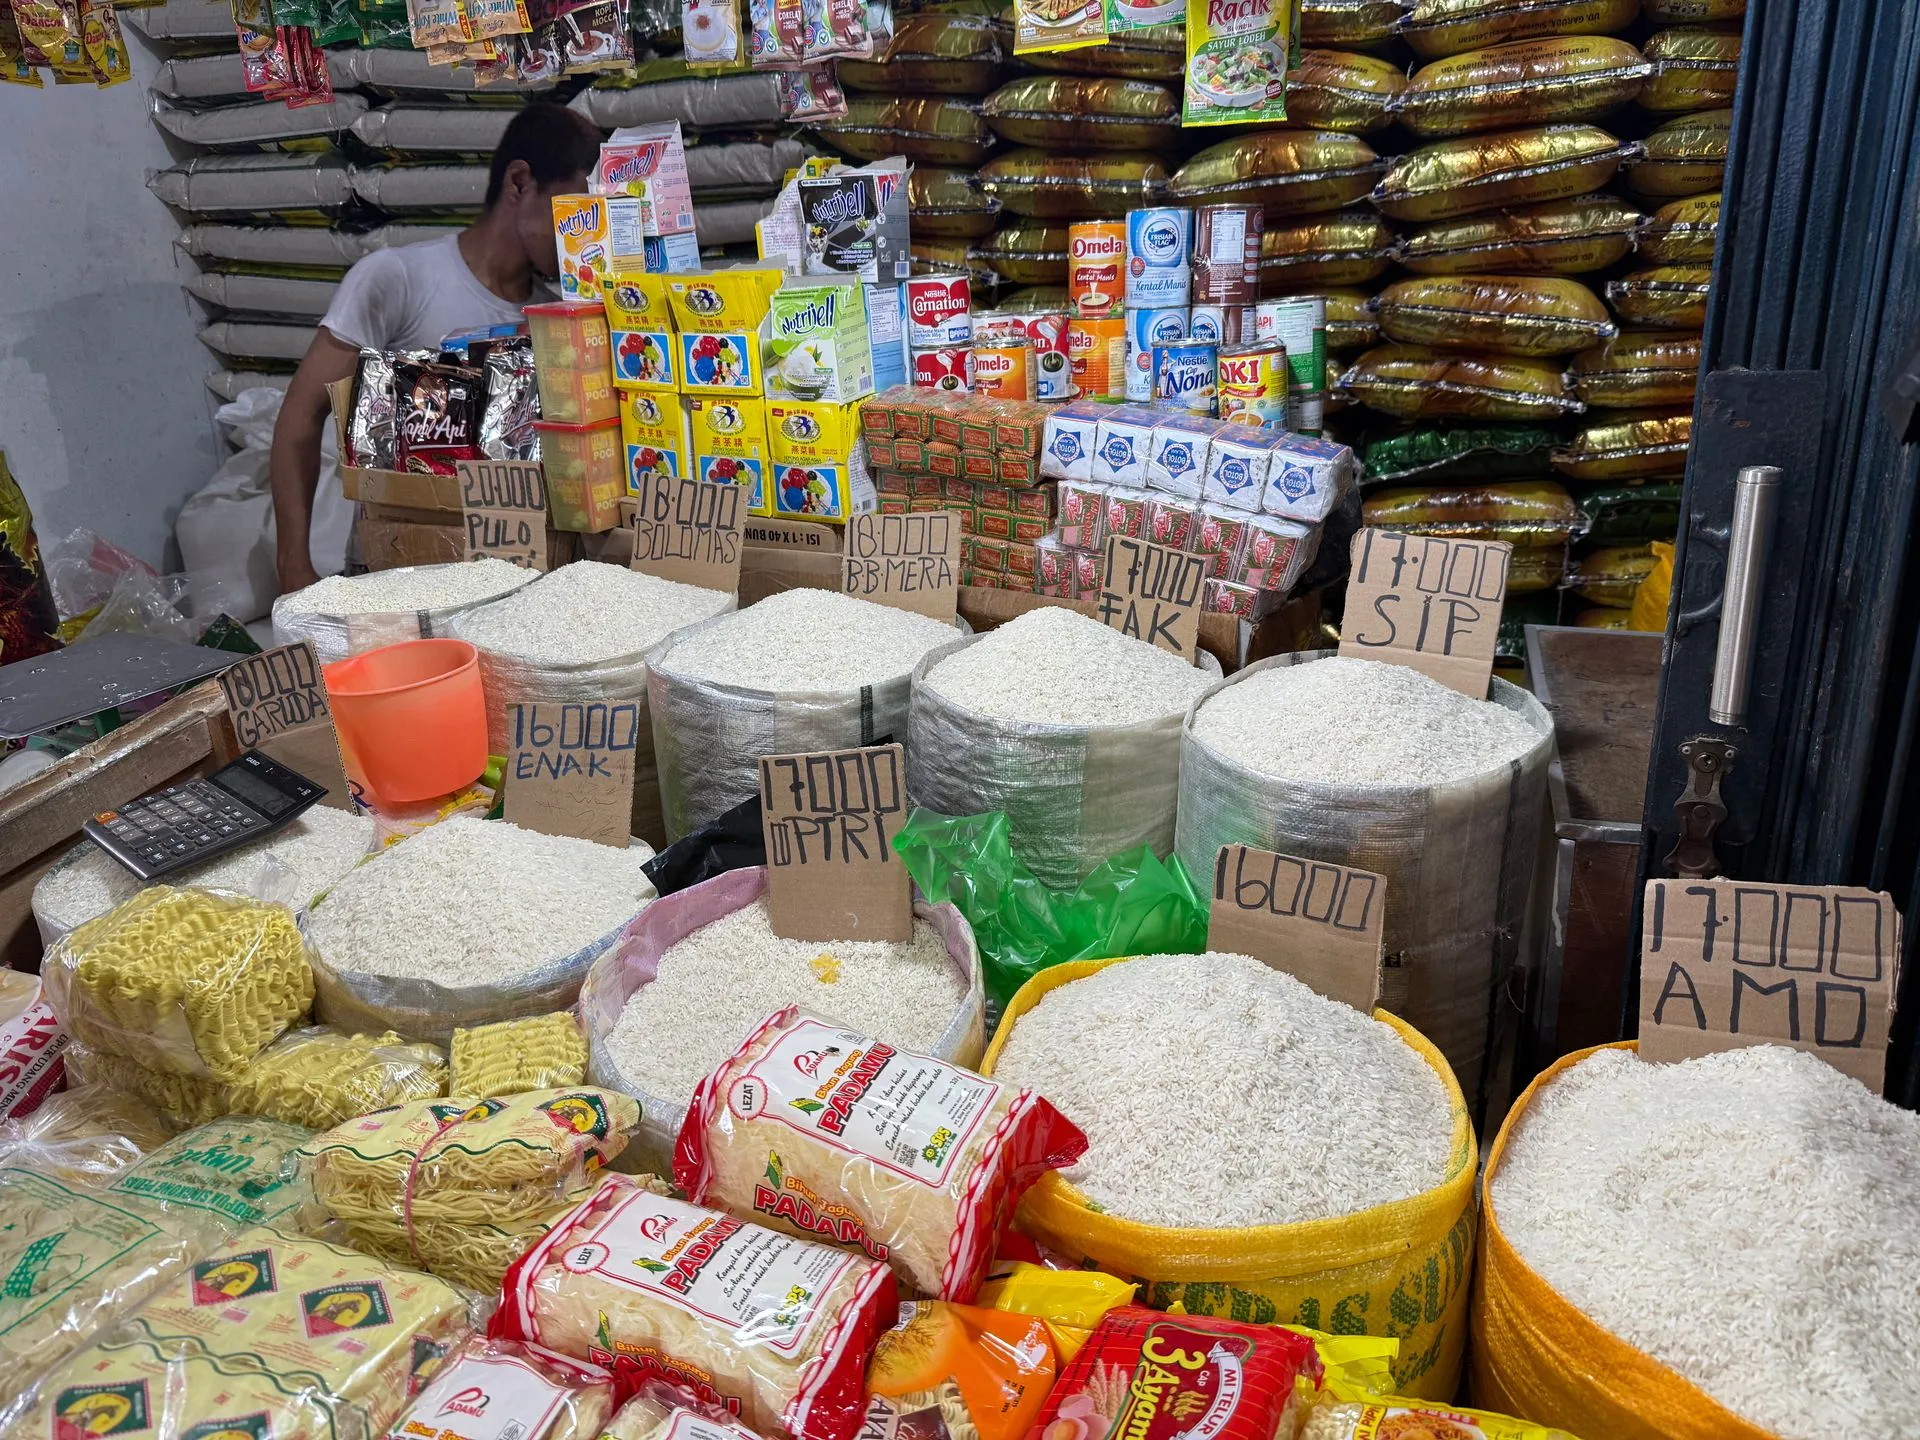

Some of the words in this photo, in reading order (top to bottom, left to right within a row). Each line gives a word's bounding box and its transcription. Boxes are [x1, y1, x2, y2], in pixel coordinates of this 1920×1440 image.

[592, 12, 618, 27] MOCCA
[595, 5, 612, 16] KOPI
[1208, 0, 1272, 27] Racik
[1207, 38, 1236, 51] SAYUR
[1239, 32, 1266, 46] LODEH
[1558, 46, 1590, 58] Selatan
[608, 145, 655, 184] Nutrijell
[811, 180, 866, 223] Nutrijell
[1694, 201, 1708, 209] UD.
[557, 202, 599, 237] Nutrijell
[1072, 237, 1123, 258] Omela
[1151, 233, 1173, 241] FRISIAN
[1136, 280, 1163, 291] Kental
[1164, 279, 1187, 290] Manis
[782, 293, 835, 335] Nutrijell
[912, 296, 966, 317] Carnation
[585, 334, 608, 347] POCI
[586, 387, 609, 400] POCI
[1166, 369, 1213, 396] Nona
[593, 447, 615, 460] POCI
[1058, 445, 1076, 454] BOTOL
[1109, 447, 1127, 457] BOTOL
[1167, 454, 1186, 464] BOTOL
[1224, 470, 1243, 480] BOTOL
[1285, 478, 1307, 489] BOTOL
[596, 498, 618, 511] POCI
[639, 473, 740, 530] 18.000
[466, 513, 531, 549] PULO
[634, 519, 740, 564] BOLOMAS
[769, 530, 781, 541] 40
[806, 533, 821, 545] ISI
[849, 514, 949, 558] 18.000
[1357, 529, 1510, 603] 17.000
[237, 688, 328, 748] GARUDA
[516, 752, 612, 780] ENAK
[1650, 883, 1882, 982] 17.000
[815, 1073, 840, 1100] Bihun
[836, 1048, 863, 1077] Jagung
[893, 1069, 908, 1088] halus
[923, 1080, 935, 1092] dan
[742, 1083, 754, 1111] LEZAT
[817, 1042, 898, 1136] PADAMU
[930, 1125, 952, 1149] SPS
[785, 1175, 817, 1203] Bihun
[818, 1199, 864, 1227] Jagung
[753, 1184, 890, 1262] PADAMU
[662, 1235, 688, 1262] Bihun
[686, 1216, 716, 1244] Jagung
[574, 1247, 593, 1266] LEZAT
[660, 1214, 748, 1296] PADAM
[716, 1254, 739, 1281] Kenyal
[732, 1287, 752, 1311] Enak
[615, 1340, 657, 1355] Bihun
[662, 1350, 713, 1382] Jagung
[1142, 1336, 1206, 1370] 3
[1198, 1370, 1211, 1387] CAP
[1224, 1368, 1237, 1386] MI
[1125, 1361, 1180, 1440] Ayam
[861, 1395, 895, 1440] AYA
[1202, 1391, 1235, 1435] TELUR
[404, 1419, 437, 1437] Bihun
